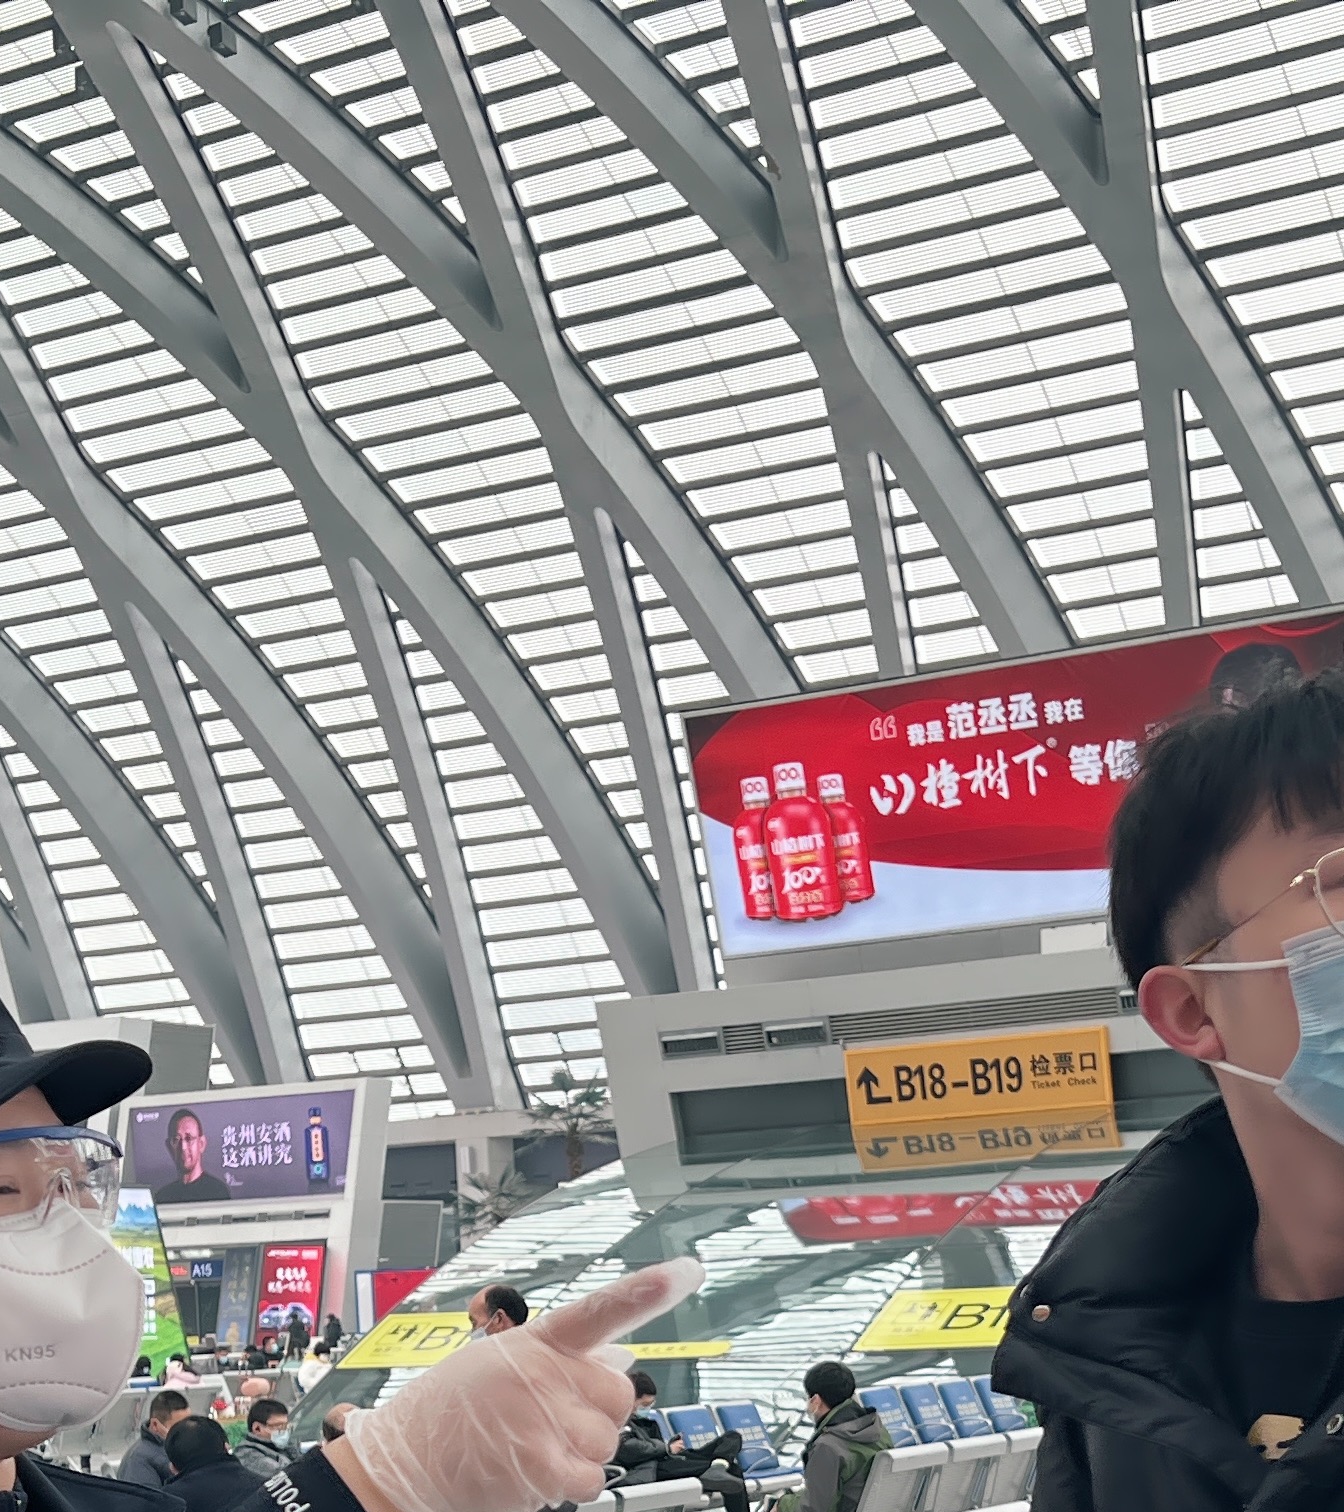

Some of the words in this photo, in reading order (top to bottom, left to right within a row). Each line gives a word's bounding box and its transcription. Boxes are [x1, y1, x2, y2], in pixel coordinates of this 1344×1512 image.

[869, 744, 1048, 816] 山楂树下
[1029, 1051, 1098, 1077] 检票口
[1030, 1079, 1062, 1090] Ticket
[1067, 1075, 1098, 1087] Check
[221, 1121, 292, 1148] 贵州安酒
[221, 1143, 293, 1168] 这酒讲究
[191, 1262, 214, 1278] A15
[939, 1302, 1010, 1331] B1
[4, 1344, 56, 1363] KN95
